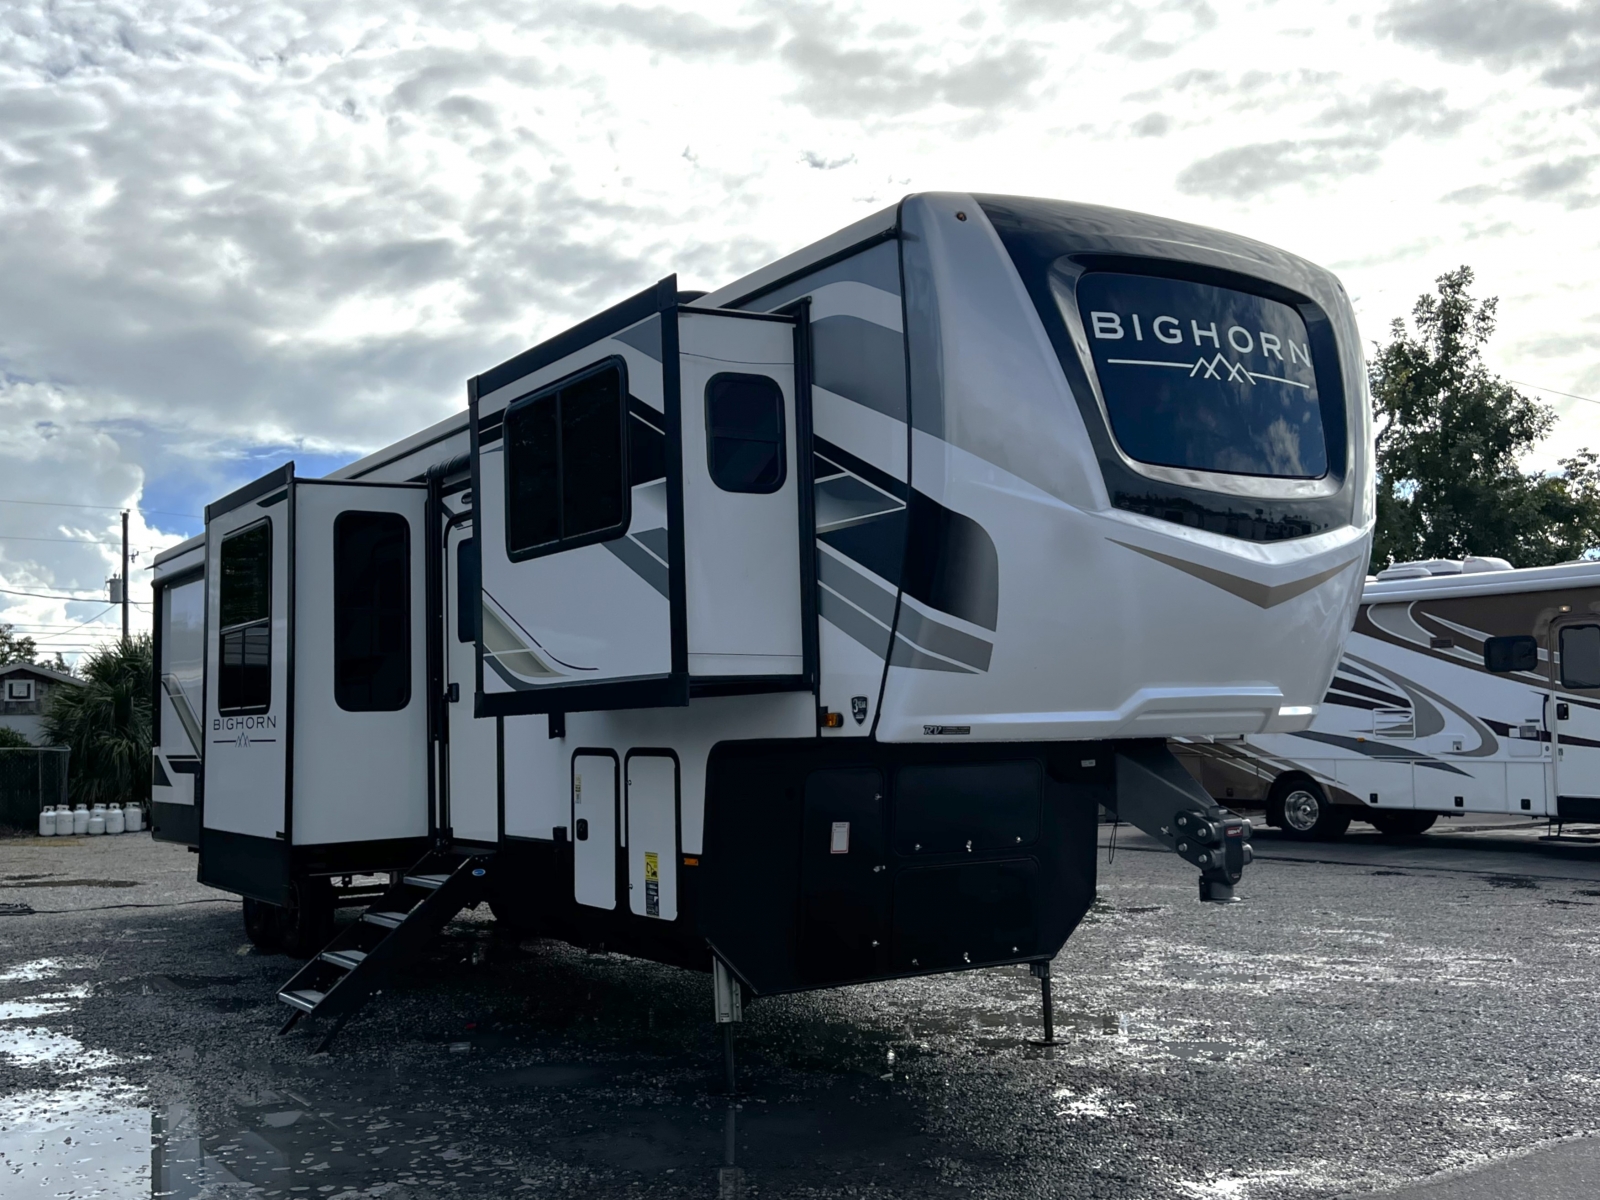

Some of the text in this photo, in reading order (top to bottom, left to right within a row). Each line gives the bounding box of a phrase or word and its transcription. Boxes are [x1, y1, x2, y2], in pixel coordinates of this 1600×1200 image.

[1091, 311, 1311, 367] BIGHORN
[213, 715, 276, 730] BIGHORN
[924, 725, 942, 735] RV
